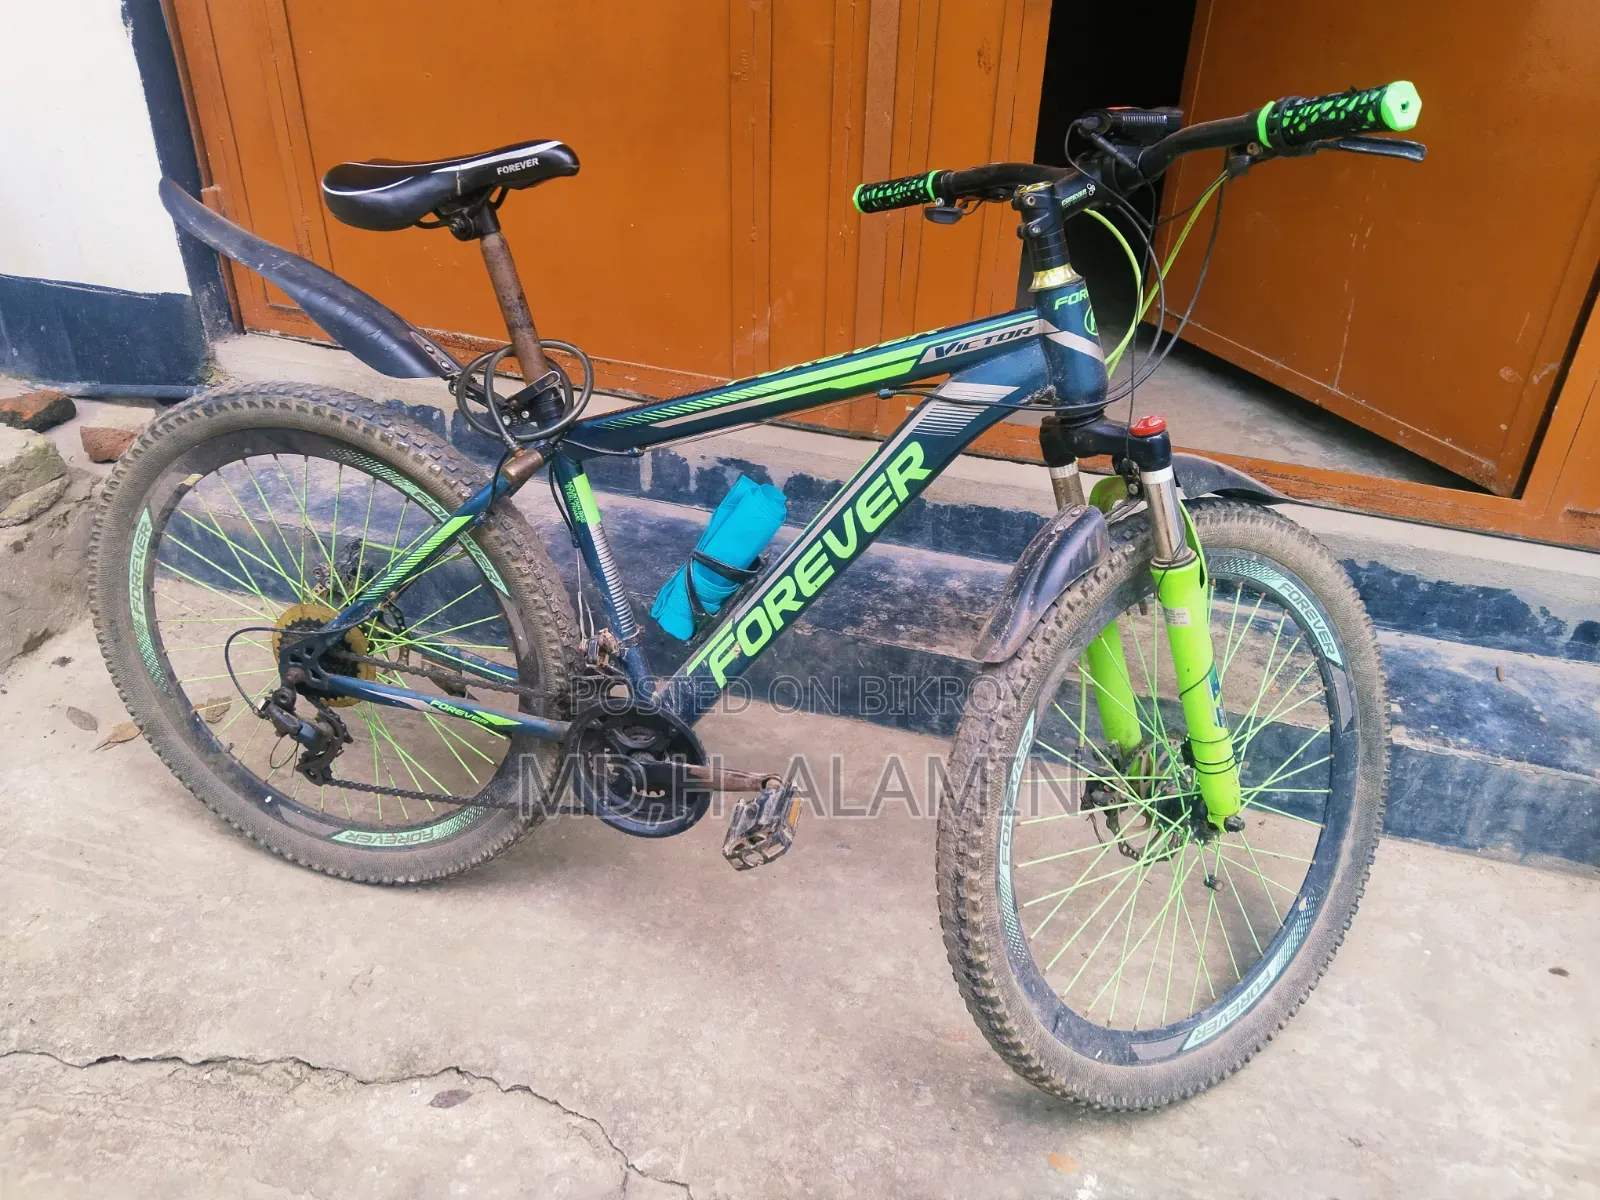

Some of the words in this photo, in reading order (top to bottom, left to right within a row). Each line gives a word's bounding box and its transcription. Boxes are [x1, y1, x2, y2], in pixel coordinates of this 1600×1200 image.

[496, 157, 539, 175] FOREVER
[934, 326, 1034, 358] VICTOR
[130, 521, 152, 616] FOREVER
[708, 441, 932, 688] FOREVER
[1277, 582, 1336, 655] FOREVER
[430, 699, 489, 725] FOREVER
[1001, 729, 1031, 866] FOREVER
[345, 827, 434, 845] FOREVER
[1194, 969, 1271, 1041] FOREVER
